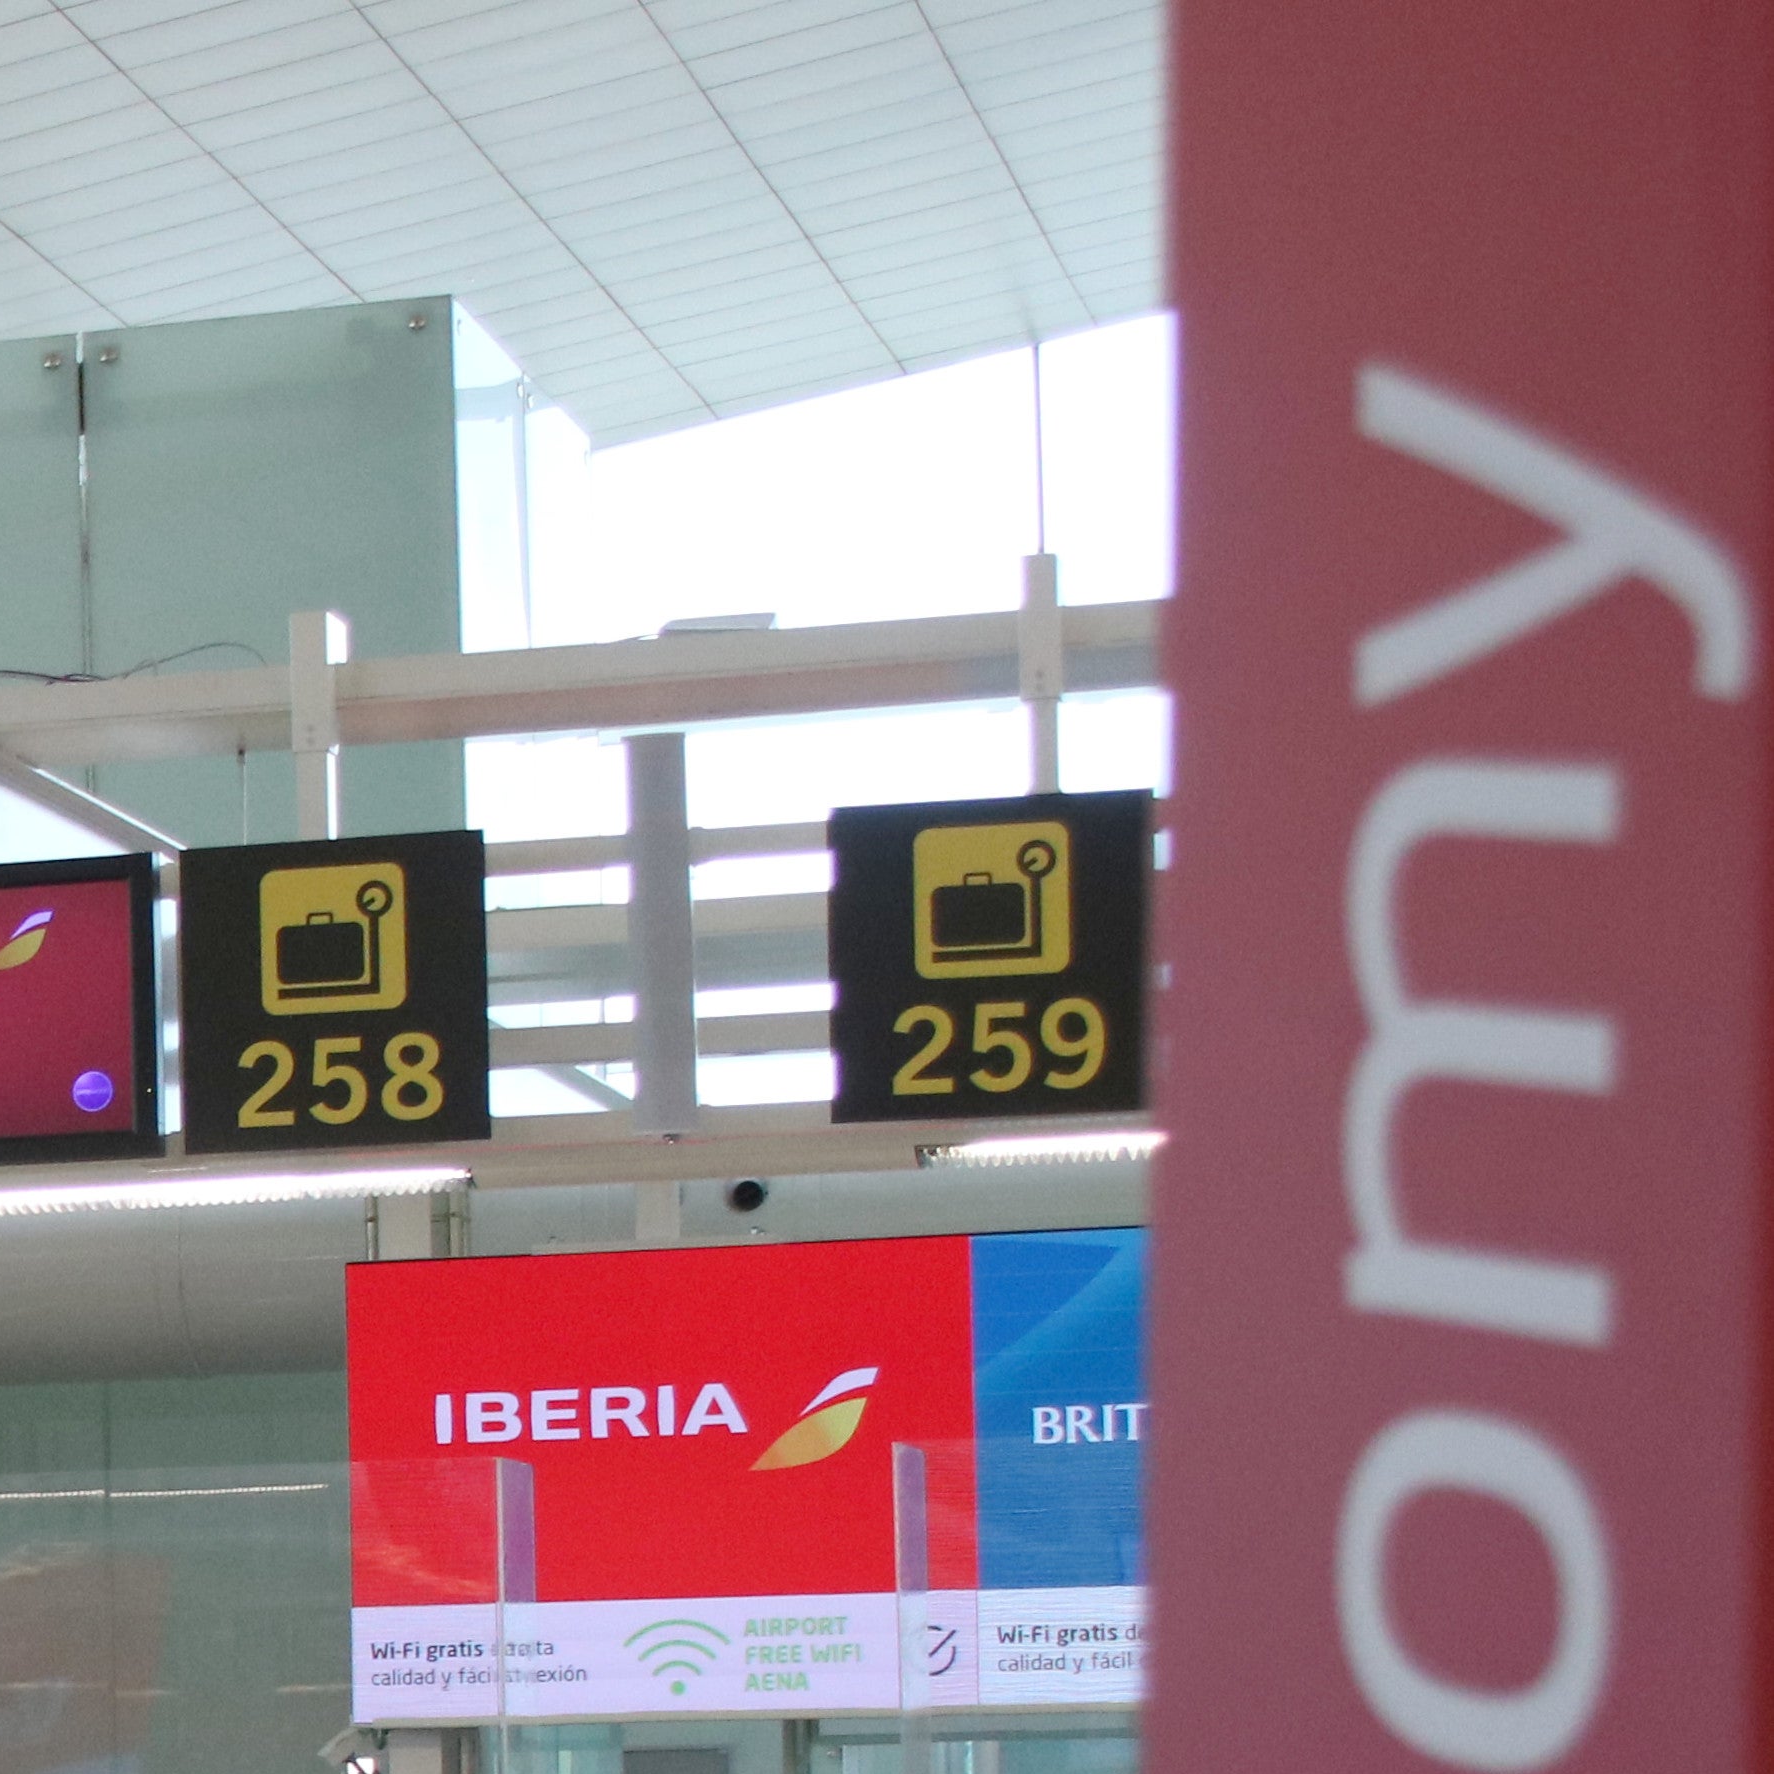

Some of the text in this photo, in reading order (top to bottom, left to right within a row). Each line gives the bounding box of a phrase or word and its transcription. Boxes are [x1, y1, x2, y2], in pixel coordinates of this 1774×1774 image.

[892, 998, 1106, 1095] 259
[237, 1032, 444, 1129] 258
[435, 1382, 747, 1444] IBERIA
[745, 1615, 847, 1637] AIRPORT
[997, 1626, 1050, 1646] Wi-Fi
[1056, 1624, 1118, 1650] gratis
[370, 1641, 420, 1660] Wi-Fi
[425, 1639, 483, 1662] gratis
[745, 1644, 862, 1664] FREE WIFI
[997, 1653, 1065, 1673] calidad
[1071, 1656, 1084, 1675] y
[1091, 1649, 1135, 1671] fácil
[370, 1665, 438, 1687] calidad
[440, 1670, 452, 1692] y
[458, 1664, 496, 1685] fáci
[745, 1673, 810, 1692] AENA
